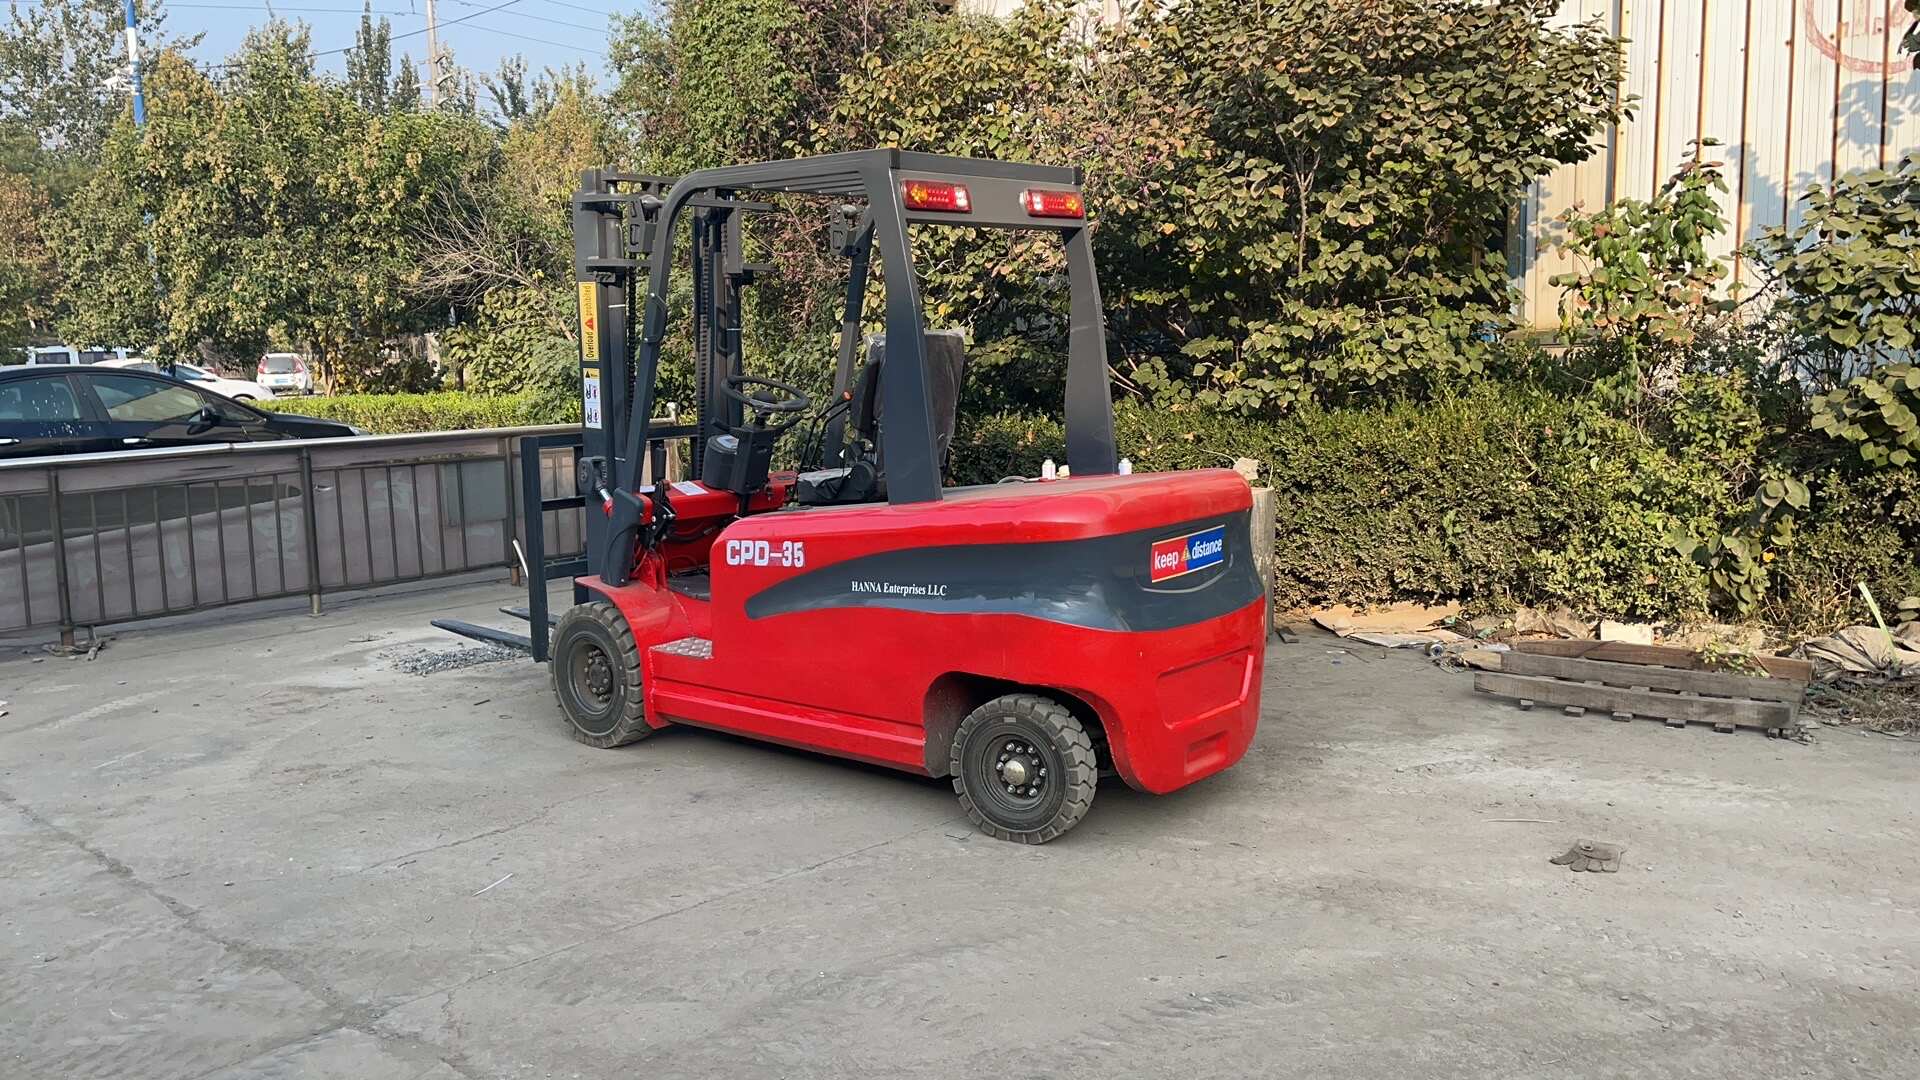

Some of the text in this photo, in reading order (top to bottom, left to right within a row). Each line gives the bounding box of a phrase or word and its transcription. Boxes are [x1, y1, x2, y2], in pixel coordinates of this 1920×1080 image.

[583, 285, 595, 358] Overload prohibited
[726, 539, 804, 567] CPD-35
[1154, 539, 1222, 570] keep distance
[851, 581, 947, 597] HANNA Enterprises LLC
